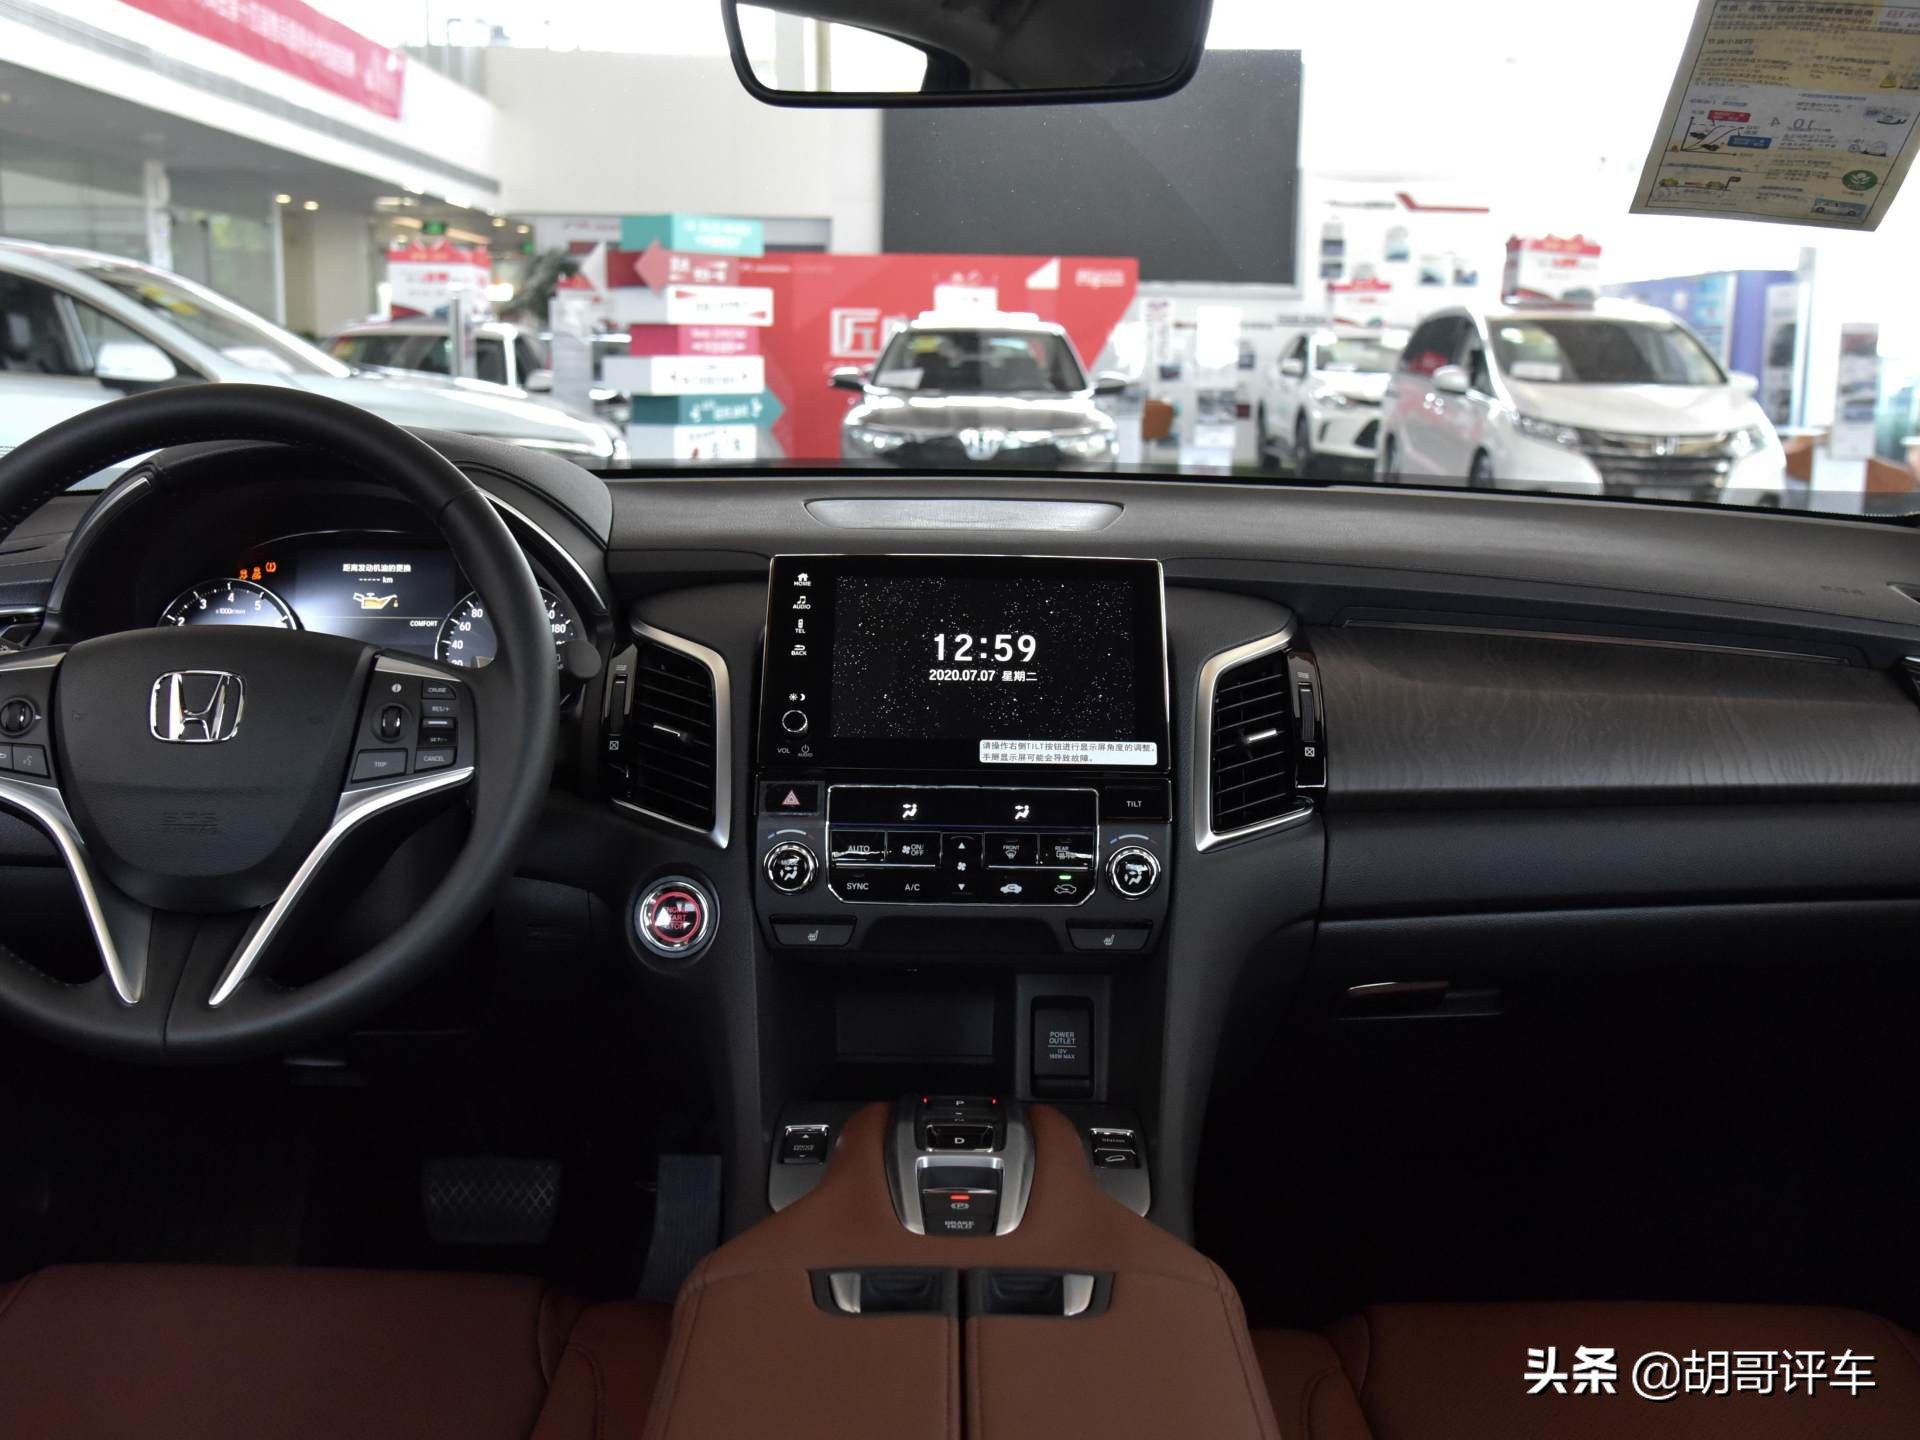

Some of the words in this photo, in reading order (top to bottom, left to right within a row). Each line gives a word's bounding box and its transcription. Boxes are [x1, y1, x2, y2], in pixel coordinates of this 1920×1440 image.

[228, 592, 235, 602] 4
[200, 599, 207, 609] 3
[254, 601, 261, 611] 5
[471, 609, 483, 618] 80
[459, 622, 471, 631] 60
[452, 640, 463, 649] 40
[934, 633, 1036, 662] 12:59
[929, 669, 996, 681] 2020.07.07
[1002, 670, 1038, 682] 星期二
[1126, 800, 1142, 808] TILT
[846, 882, 869, 890] SYNC
[1048, 1037, 1076, 1045] OUTLET
